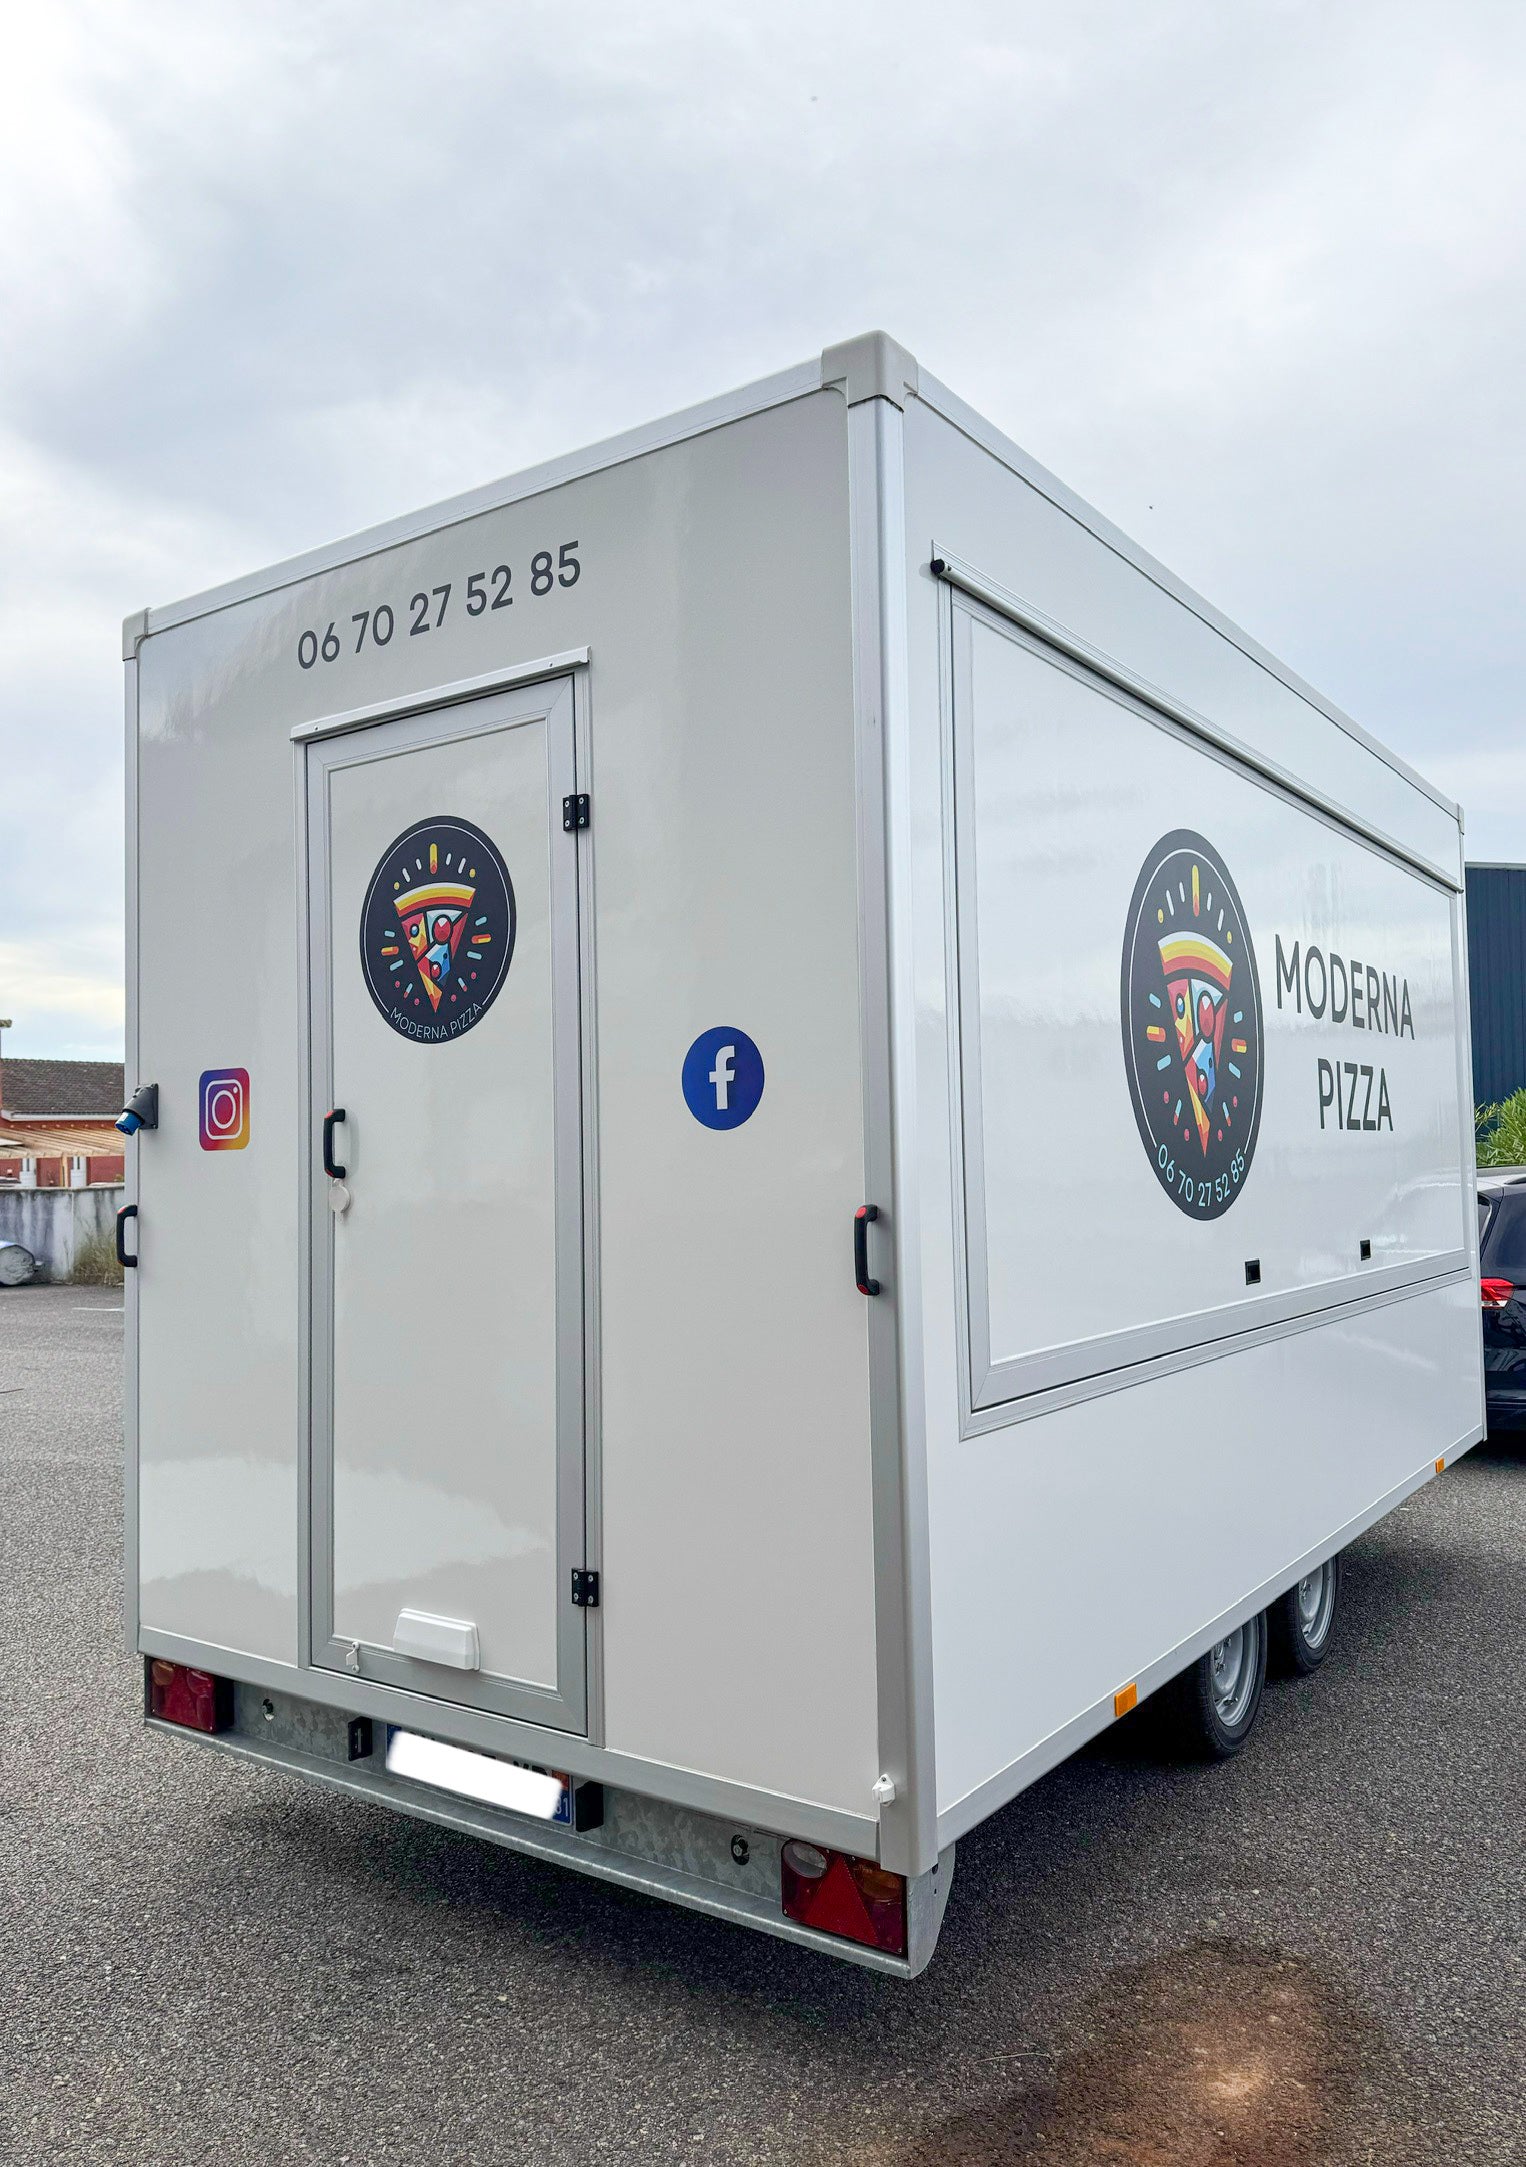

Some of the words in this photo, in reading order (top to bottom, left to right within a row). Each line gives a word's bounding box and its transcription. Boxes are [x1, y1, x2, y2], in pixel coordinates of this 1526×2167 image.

[298, 622, 340, 670] 06
[351, 604, 394, 654] 70
[409, 583, 452, 637] 27
[466, 564, 513, 617] 52
[530, 540, 581, 597] 85
[390, 1006, 448, 1039] MODERNA
[450, 1002, 482, 1034] PIZZA
[1275, 933, 1415, 1040] MODERNA
[708, 1045, 736, 1110] f
[1317, 1058, 1394, 1131] PIZZA
[1158, 1143, 1175, 1183] 06
[1178, 1169, 1194, 1202] 70
[1198, 1182, 1212, 1207] 27
[1215, 1172, 1231, 1202] 52
[1230, 1147, 1245, 1183] 85
